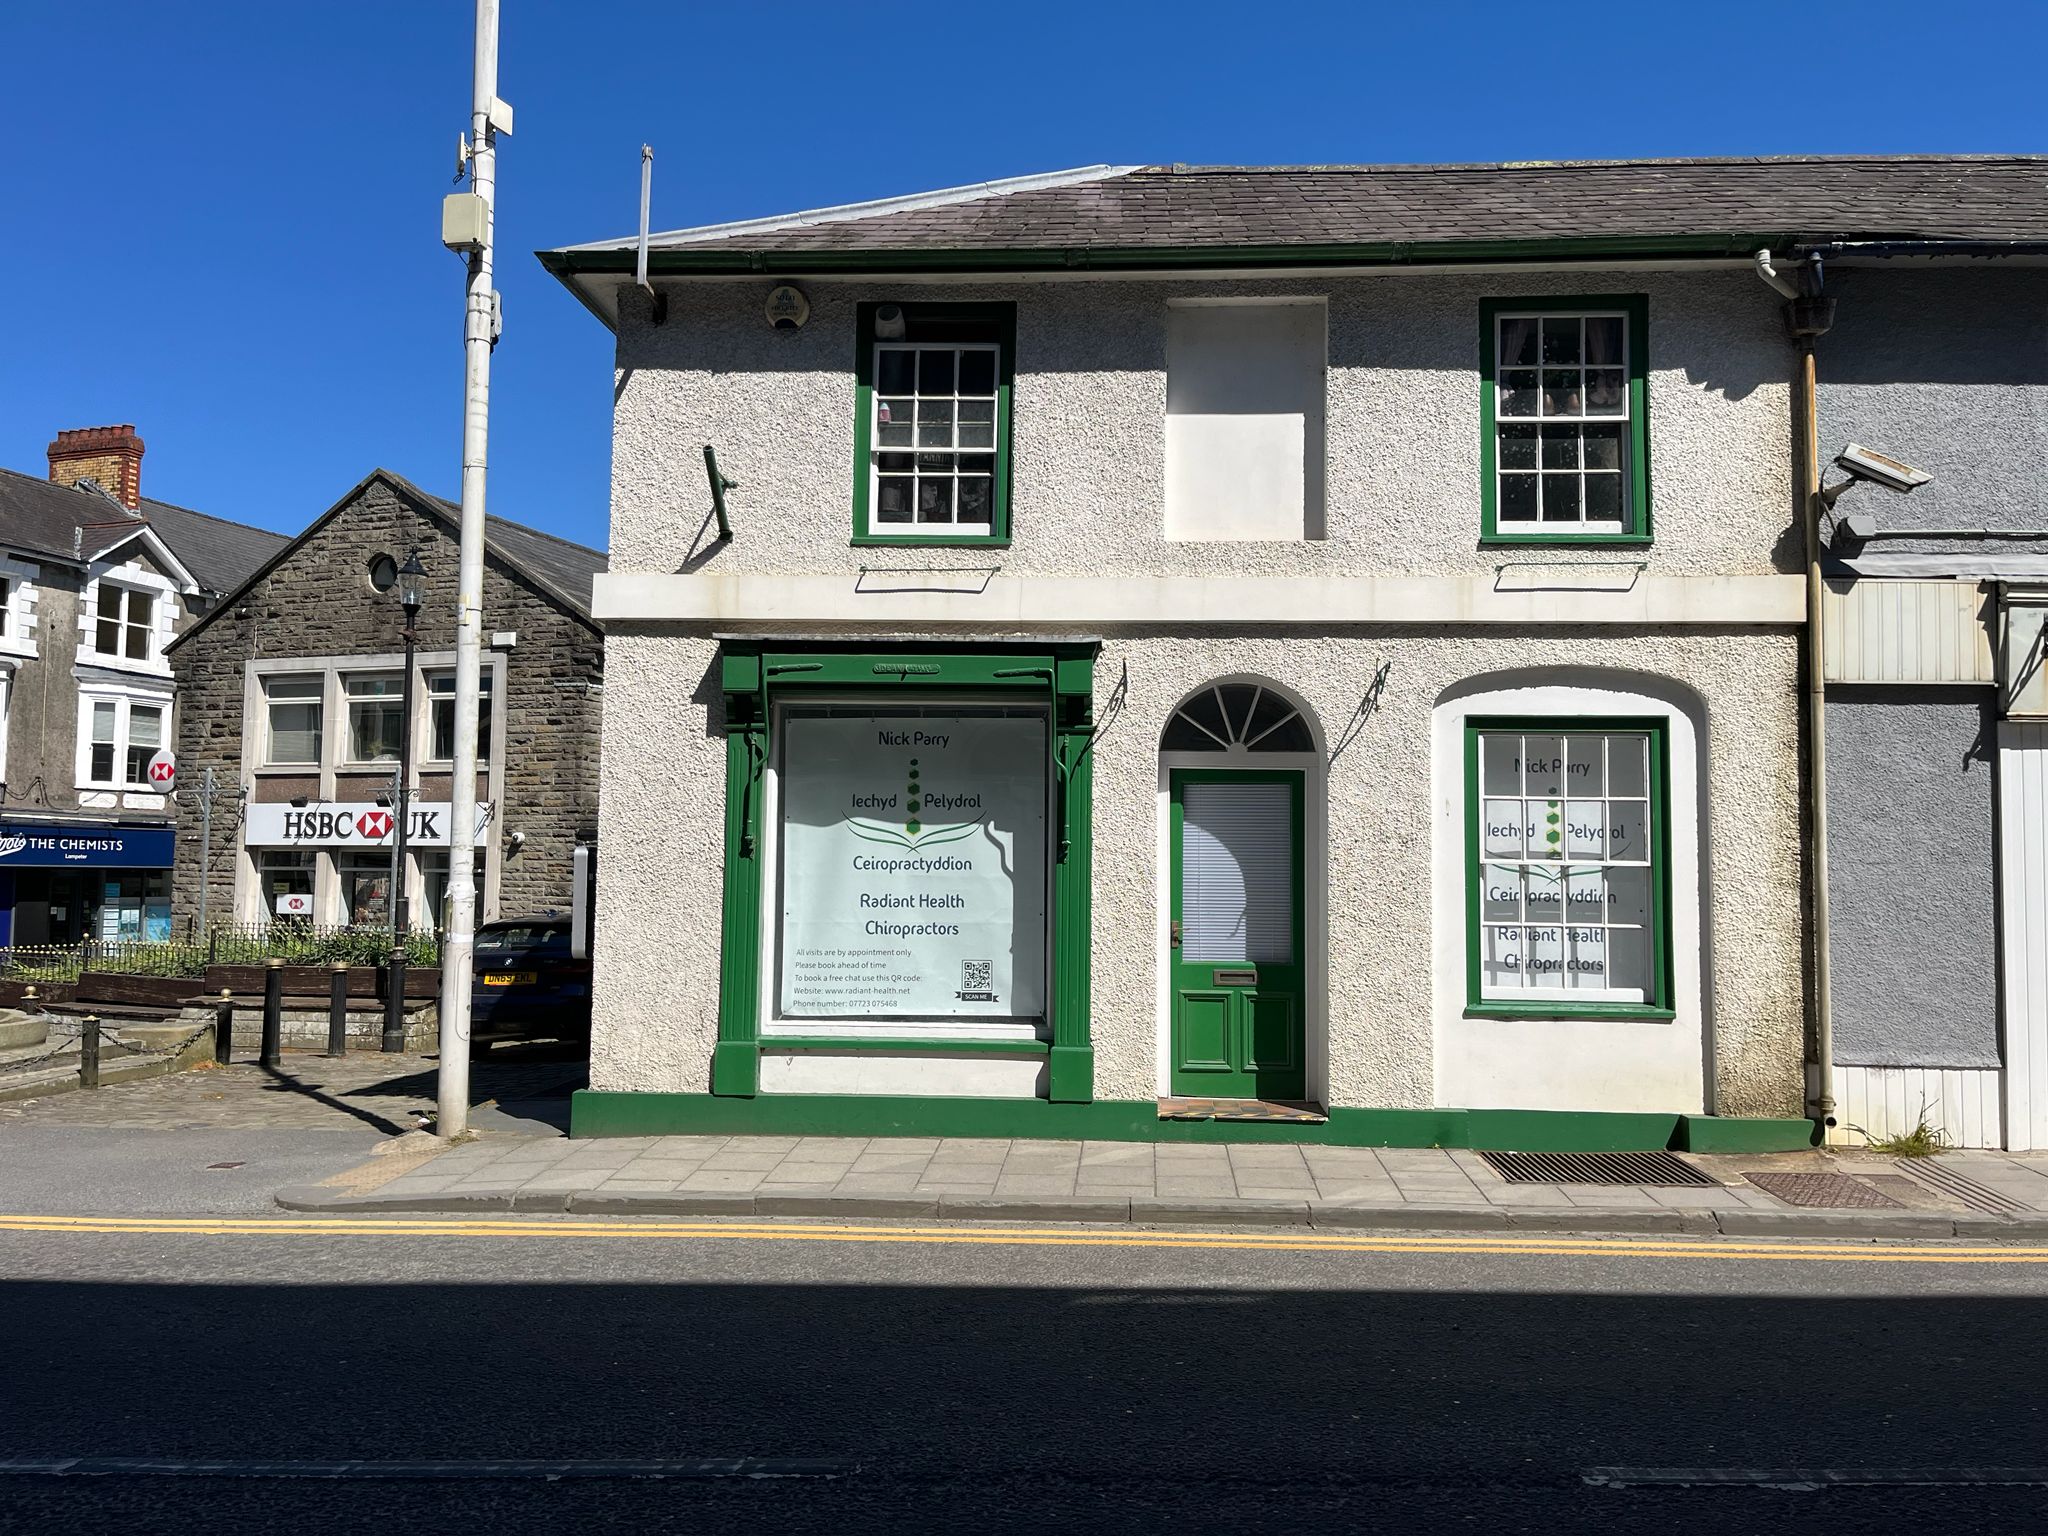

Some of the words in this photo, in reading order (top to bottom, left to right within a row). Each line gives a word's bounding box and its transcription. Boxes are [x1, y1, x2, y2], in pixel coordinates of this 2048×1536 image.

[878, 732, 910, 746] Nick
[914, 733, 949, 748] Parry
[853, 794, 897, 811] Iechyd
[924, 794, 981, 811] Pelydrol
[283, 812, 353, 839] HSBC
[407, 812, 441, 839] UK
[0, 832, 27, 856] oots
[29, 838, 55, 849] THE
[60, 839, 123, 851] CHEMISTS
[853, 856, 972, 873] Ceiropractyddion
[860, 894, 914, 908] Radiant
[919, 894, 964, 908] Health
[1490, 886, 1617, 906] Ceirpracyddin
[865, 921, 959, 938] Chiropractors
[1498, 926, 1556, 942] Raiant
[838, 949, 846, 957] by
[896, 949, 911, 957] only
